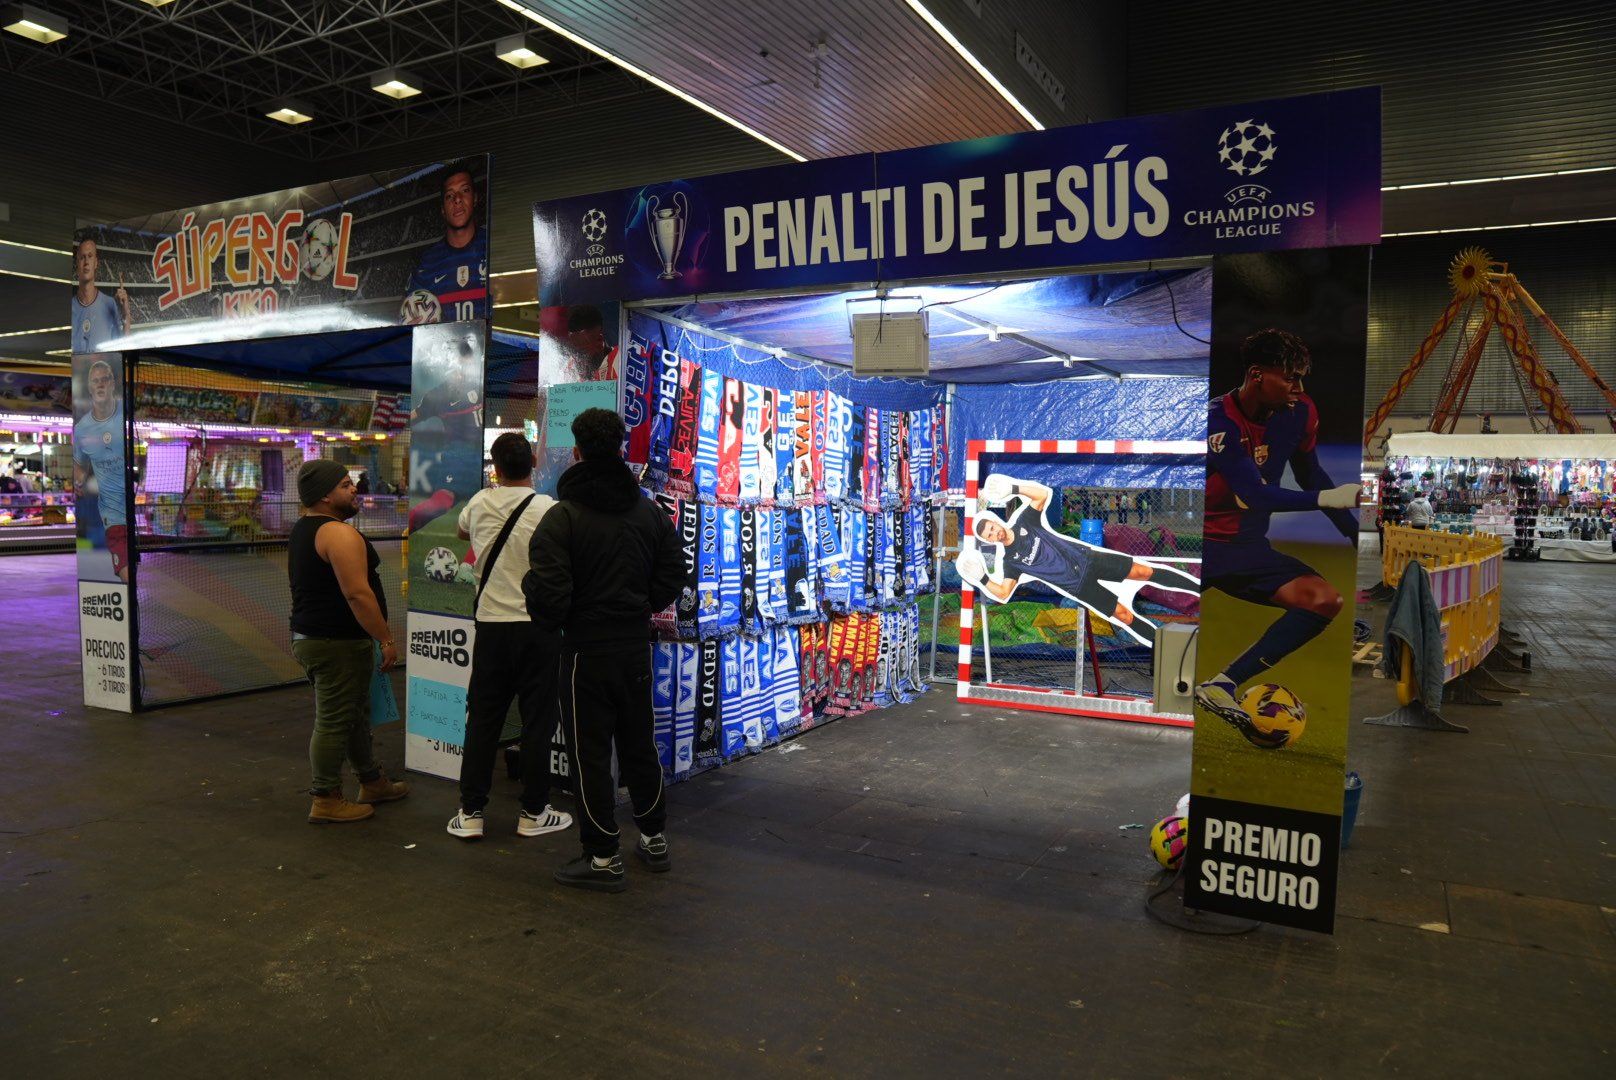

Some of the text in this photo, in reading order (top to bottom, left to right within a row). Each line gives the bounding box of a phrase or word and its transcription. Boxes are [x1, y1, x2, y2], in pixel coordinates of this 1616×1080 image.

[1226, 186, 1268, 203] UEFA
[723, 143, 1171, 273] PENALTI DE JESÚS
[1184, 200, 1316, 227] CHAMPIONS
[1215, 222, 1282, 240] LEAGUE
[569, 253, 625, 270] CHAMPIONS
[579, 265, 617, 279] LEAGUE
[223, 287, 278, 320] KIKO
[795, 391, 811, 459] VALE
[82, 591, 122, 607] PREMIO
[82, 606, 125, 622] SEGURO
[411, 628, 467, 648] PREMIO
[86, 638, 126, 661] PRECIOS
[410, 642, 470, 668] SEGURO
[107, 664, 126, 679] TIROS
[107, 680, 126, 694] TIROS
[1203, 817, 1322, 868] PREMIO
[1200, 859, 1321, 911] SEGURO
